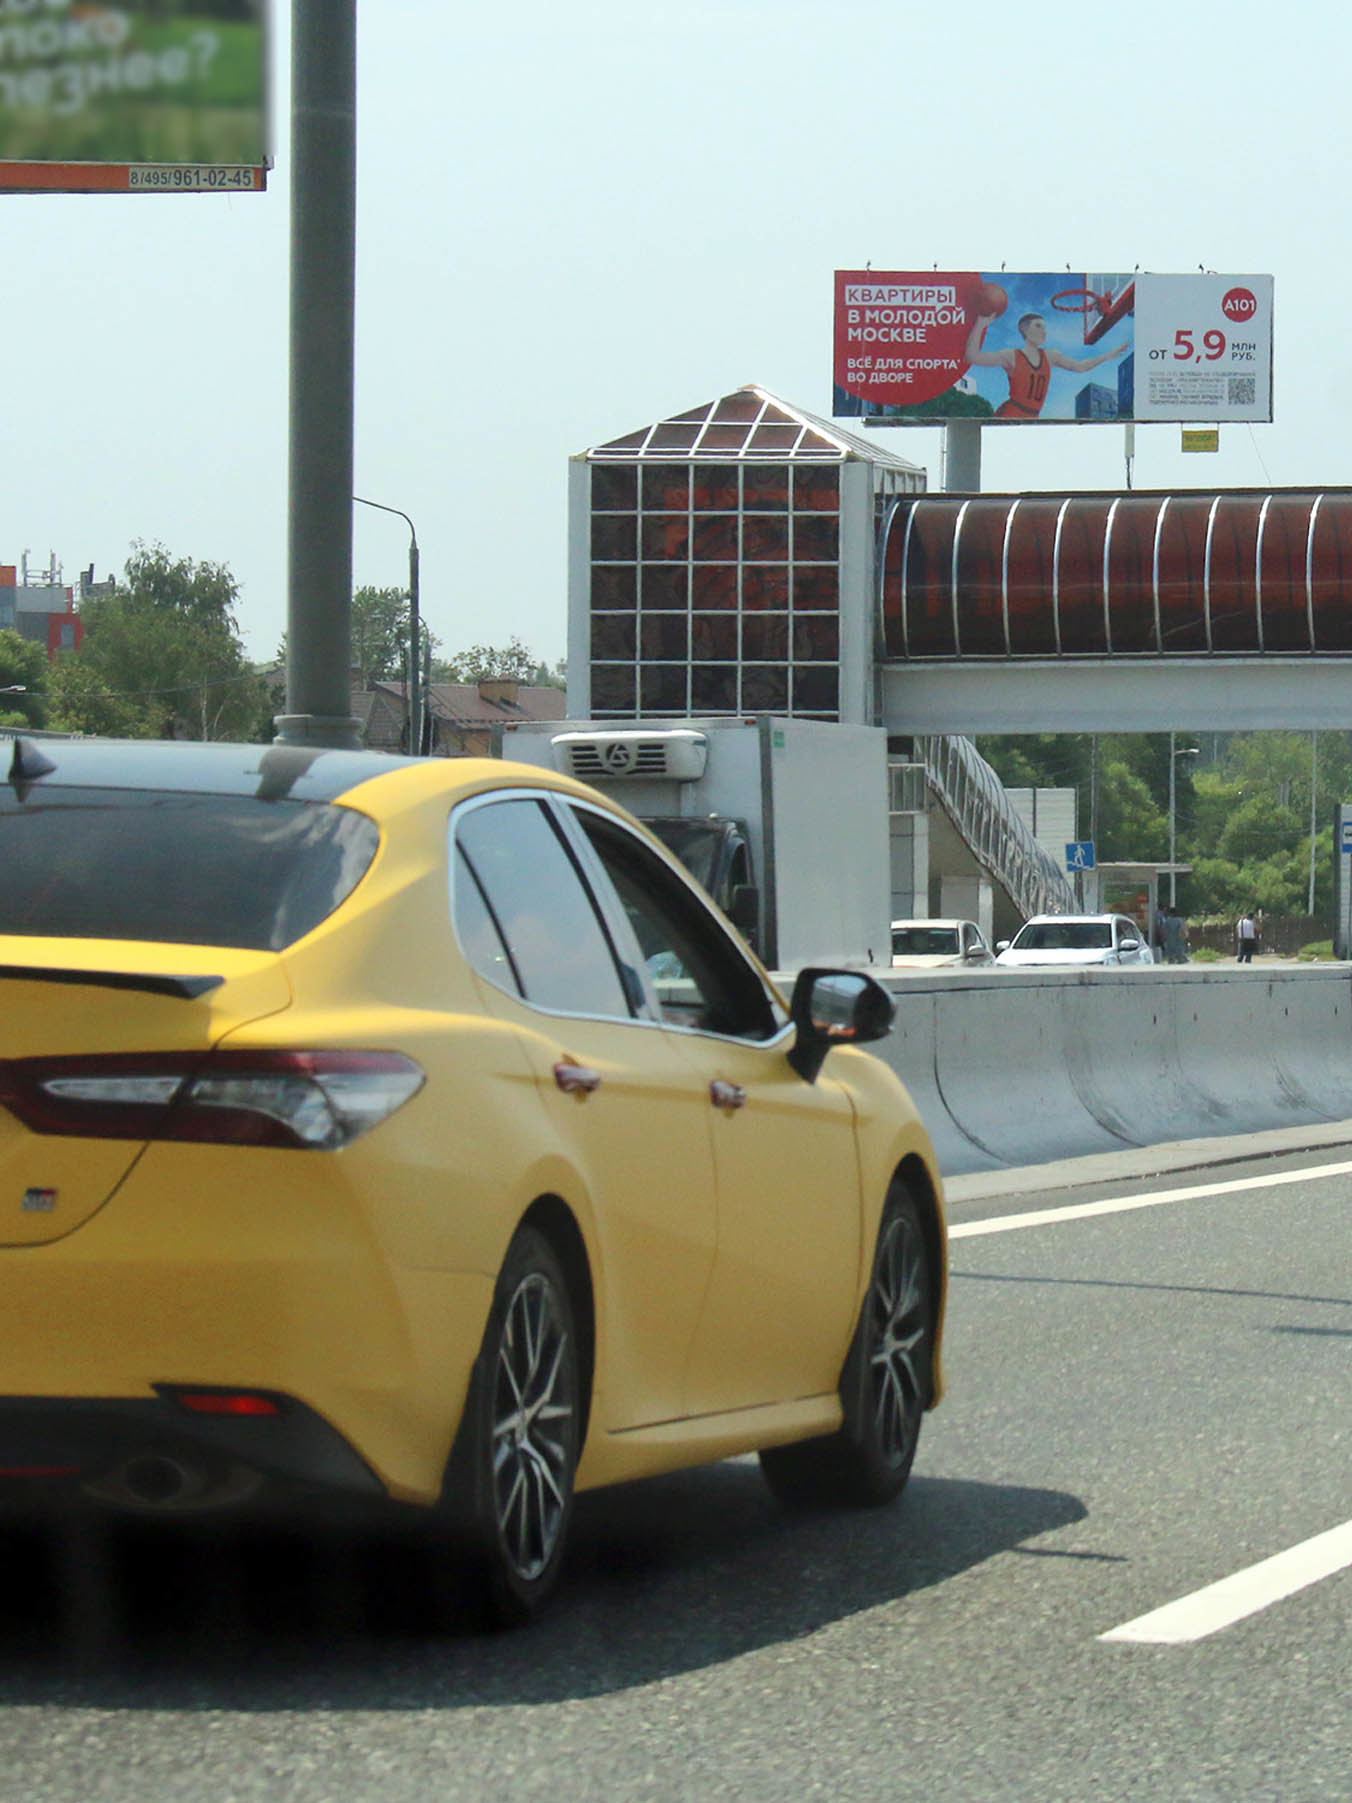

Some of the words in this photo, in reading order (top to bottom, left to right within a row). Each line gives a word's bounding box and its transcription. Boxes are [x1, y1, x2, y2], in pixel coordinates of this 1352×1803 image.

[130, 169, 252, 186] 8/495/961-02-45
[847, 288, 953, 303] КВАРТИРЫ
[848, 310, 860, 324] В
[865, 307, 966, 327] МОЛОДОЙ
[848, 327, 927, 343] МОСКВЕ
[1149, 349, 1168, 360] ОТ
[1173, 329, 1227, 364] 5,9
[1231, 343, 1256, 351] МЛН
[847, 356, 872, 369] ВСЁ
[874, 359, 903, 370] ДЛЯ
[1231, 351, 1256, 361] РУБ.
[847, 372, 866, 383] ВО
[868, 372, 913, 384] ДВОРЕ
